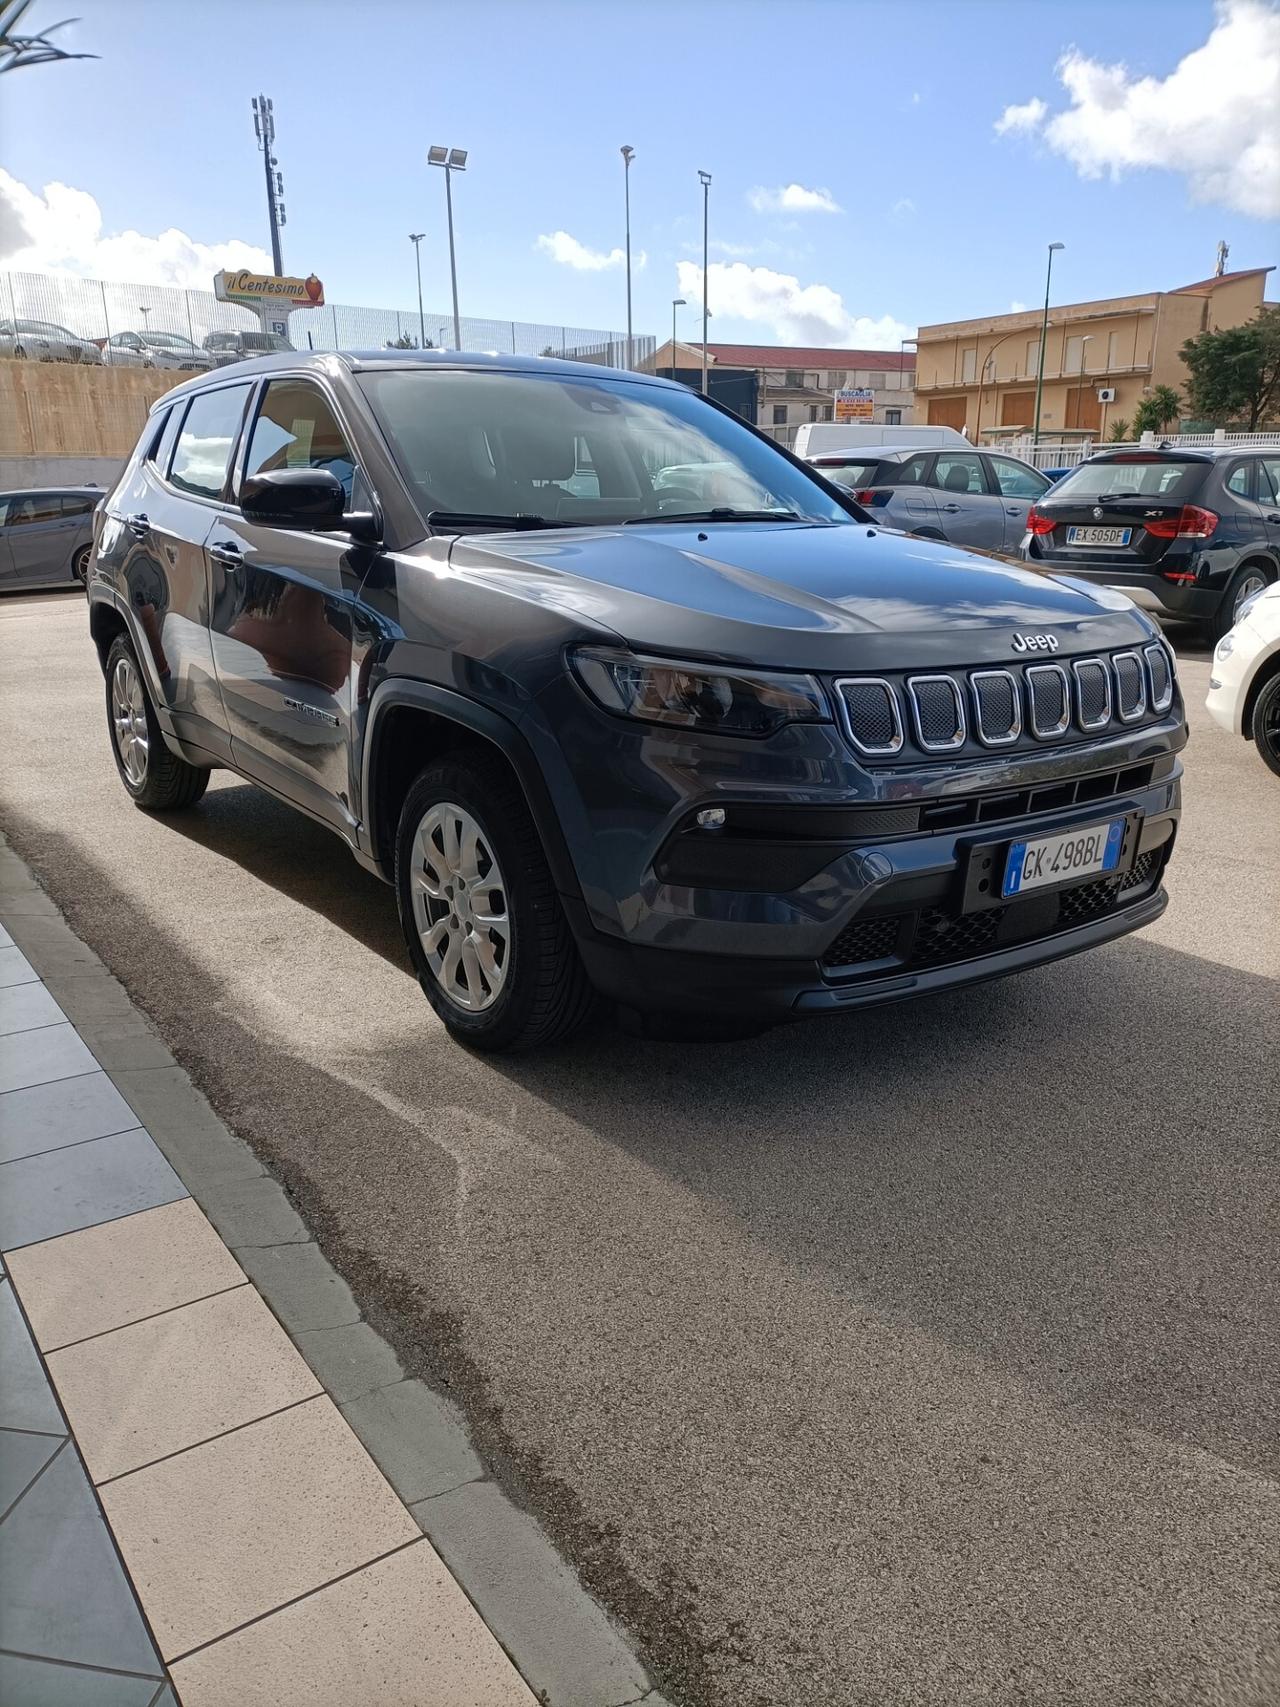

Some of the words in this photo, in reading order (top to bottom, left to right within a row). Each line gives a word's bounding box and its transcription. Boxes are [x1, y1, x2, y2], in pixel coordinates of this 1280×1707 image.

[227, 276, 237, 289] il
[238, 273, 304, 296] Centesimo
[1076, 528, 1088, 541] EX
[1090, 529, 1123, 542] 505DF
[1011, 633, 1059, 653] Jeep
[1022, 846, 1047, 880] GK
[1050, 834, 1102, 873] 498BL
